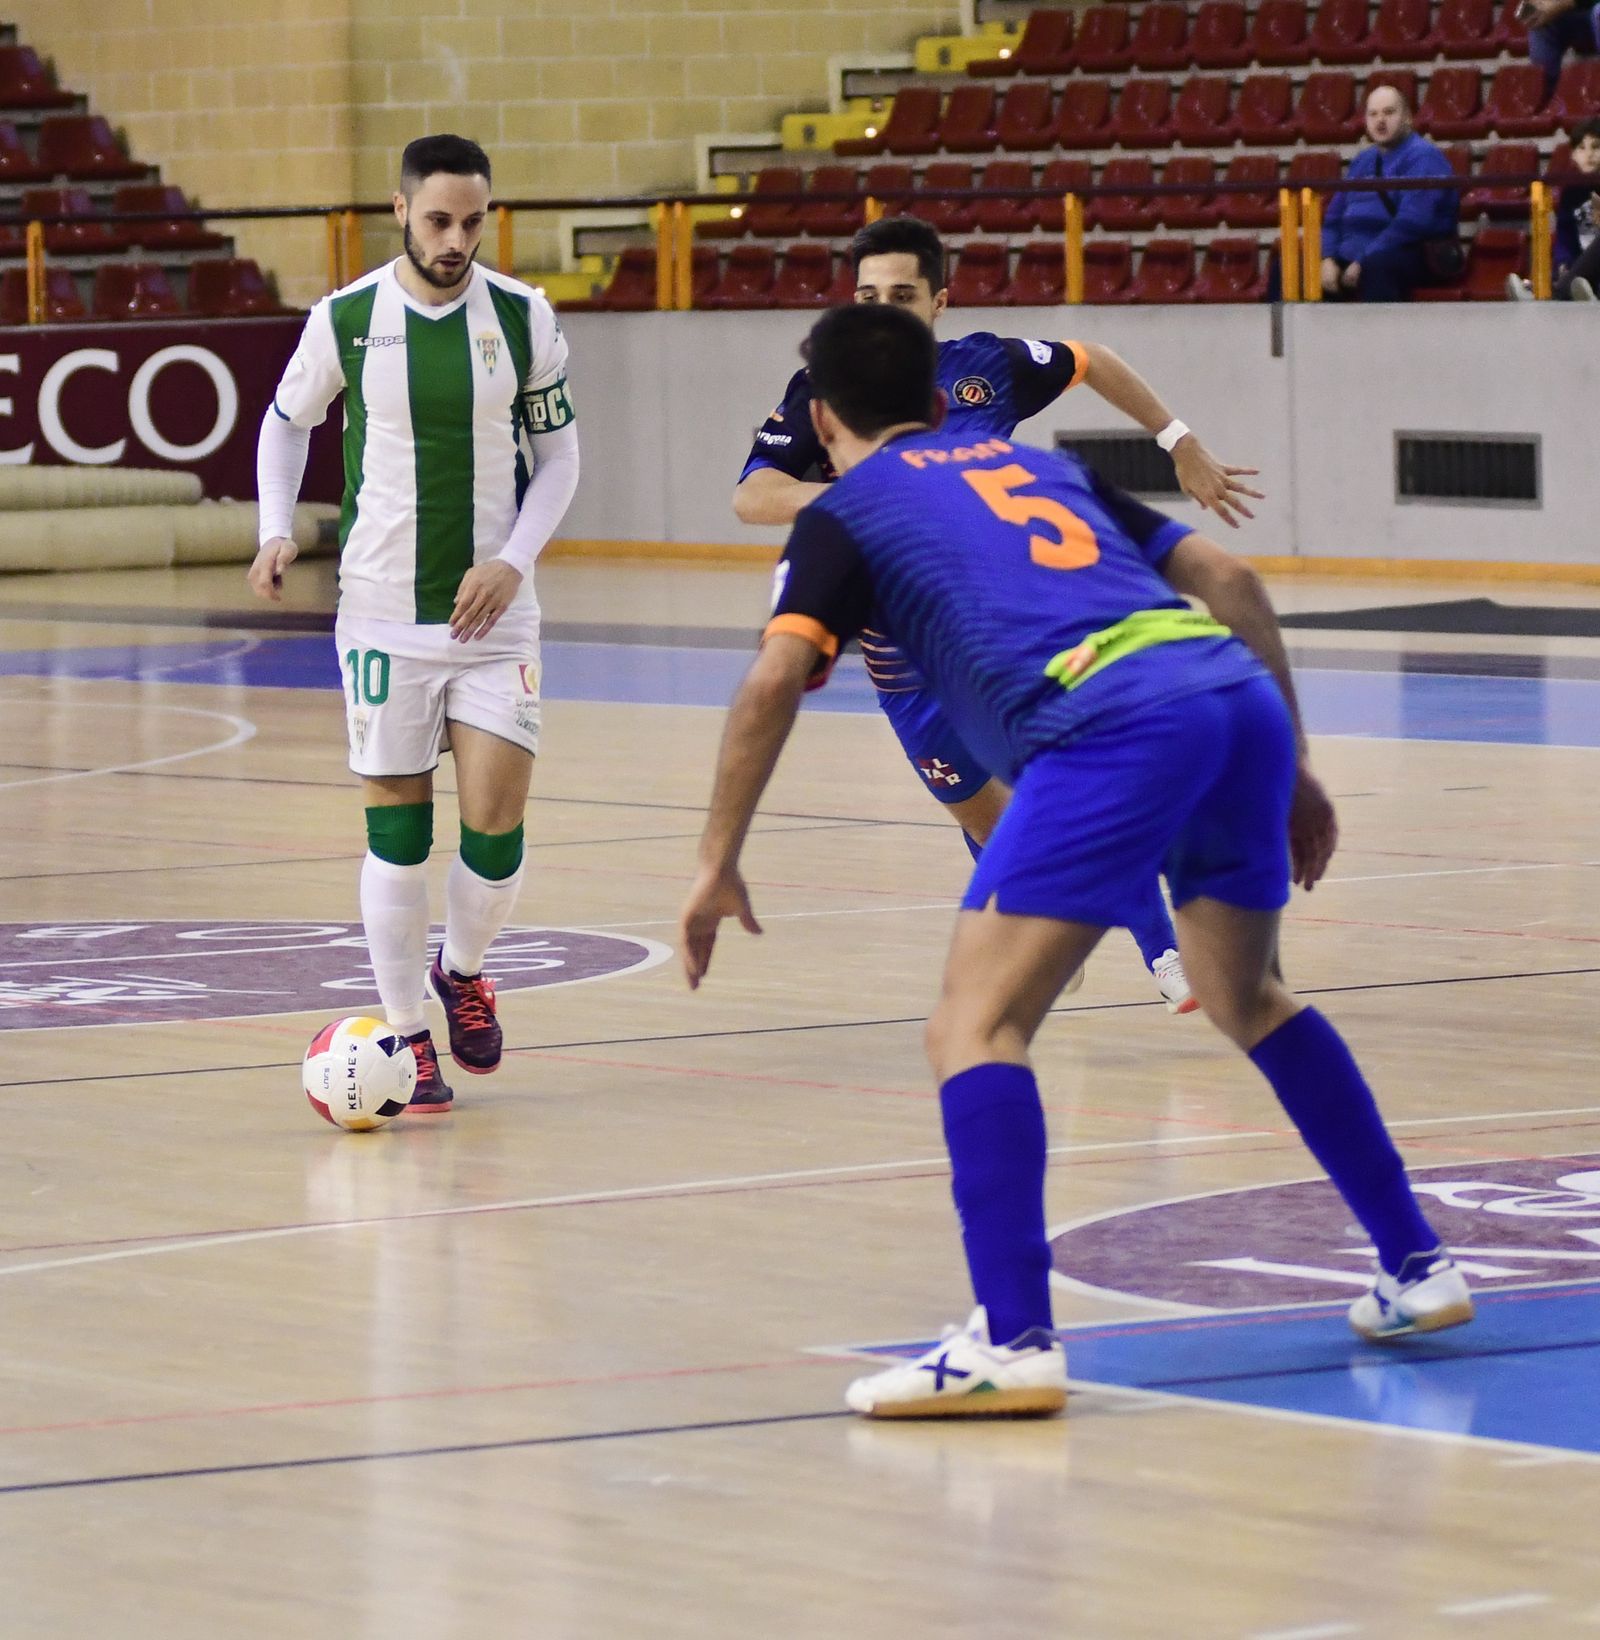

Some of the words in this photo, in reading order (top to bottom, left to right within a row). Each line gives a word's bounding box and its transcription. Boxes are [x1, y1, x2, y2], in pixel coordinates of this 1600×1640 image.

[353, 336, 405, 347] Kappa
[960, 464, 1101, 571] 5
[346, 648, 391, 705] 10
